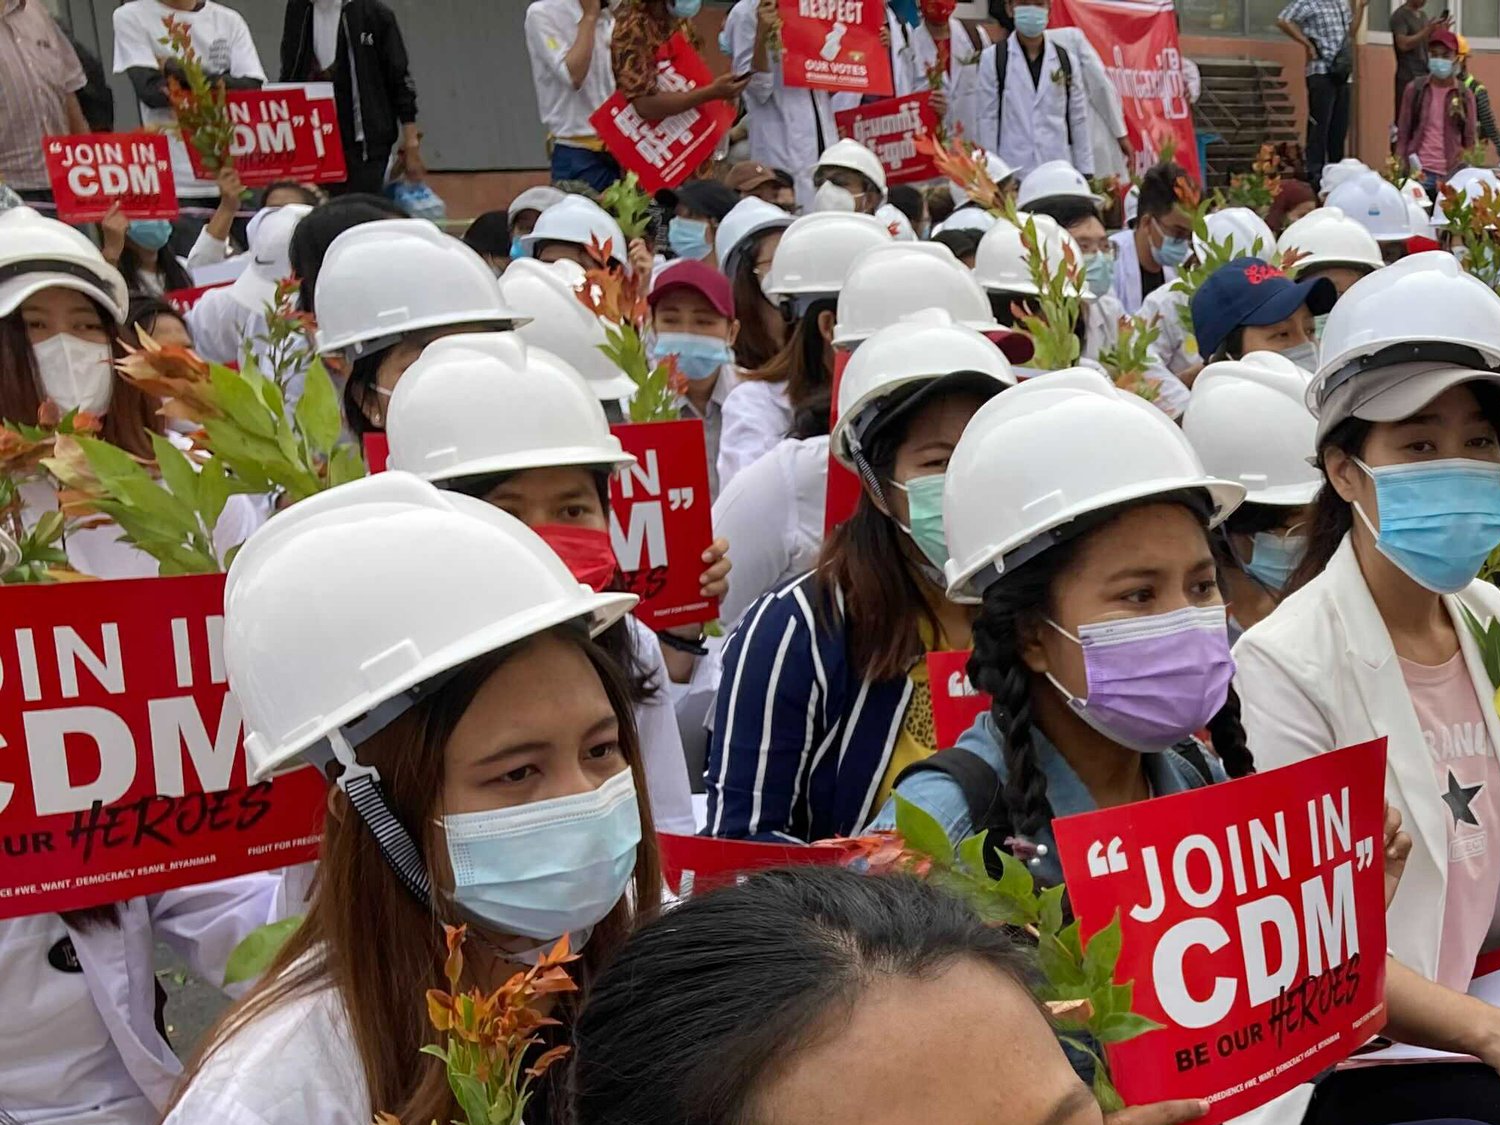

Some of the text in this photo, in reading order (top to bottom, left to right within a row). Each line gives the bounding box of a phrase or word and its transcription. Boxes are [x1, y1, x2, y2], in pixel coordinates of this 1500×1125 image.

[805, 59, 867, 76] OUR VOTES
[261, 100, 289, 122] IN
[50, 142, 156, 168] “JOIN IN
[230, 115, 304, 156] DM”
[67, 160, 167, 196] CDM”
[0, 691, 273, 816] DM
[66, 781, 274, 864] HEROES
[274, 840, 291, 851] FOR
[1088, 786, 1351, 922] “JOIN IN
[1152, 836, 1374, 1029] CDM”
[1175, 1042, 1210, 1073] BE
[1216, 1023, 1264, 1060] OUR
[1269, 952, 1361, 1049] HEROES
